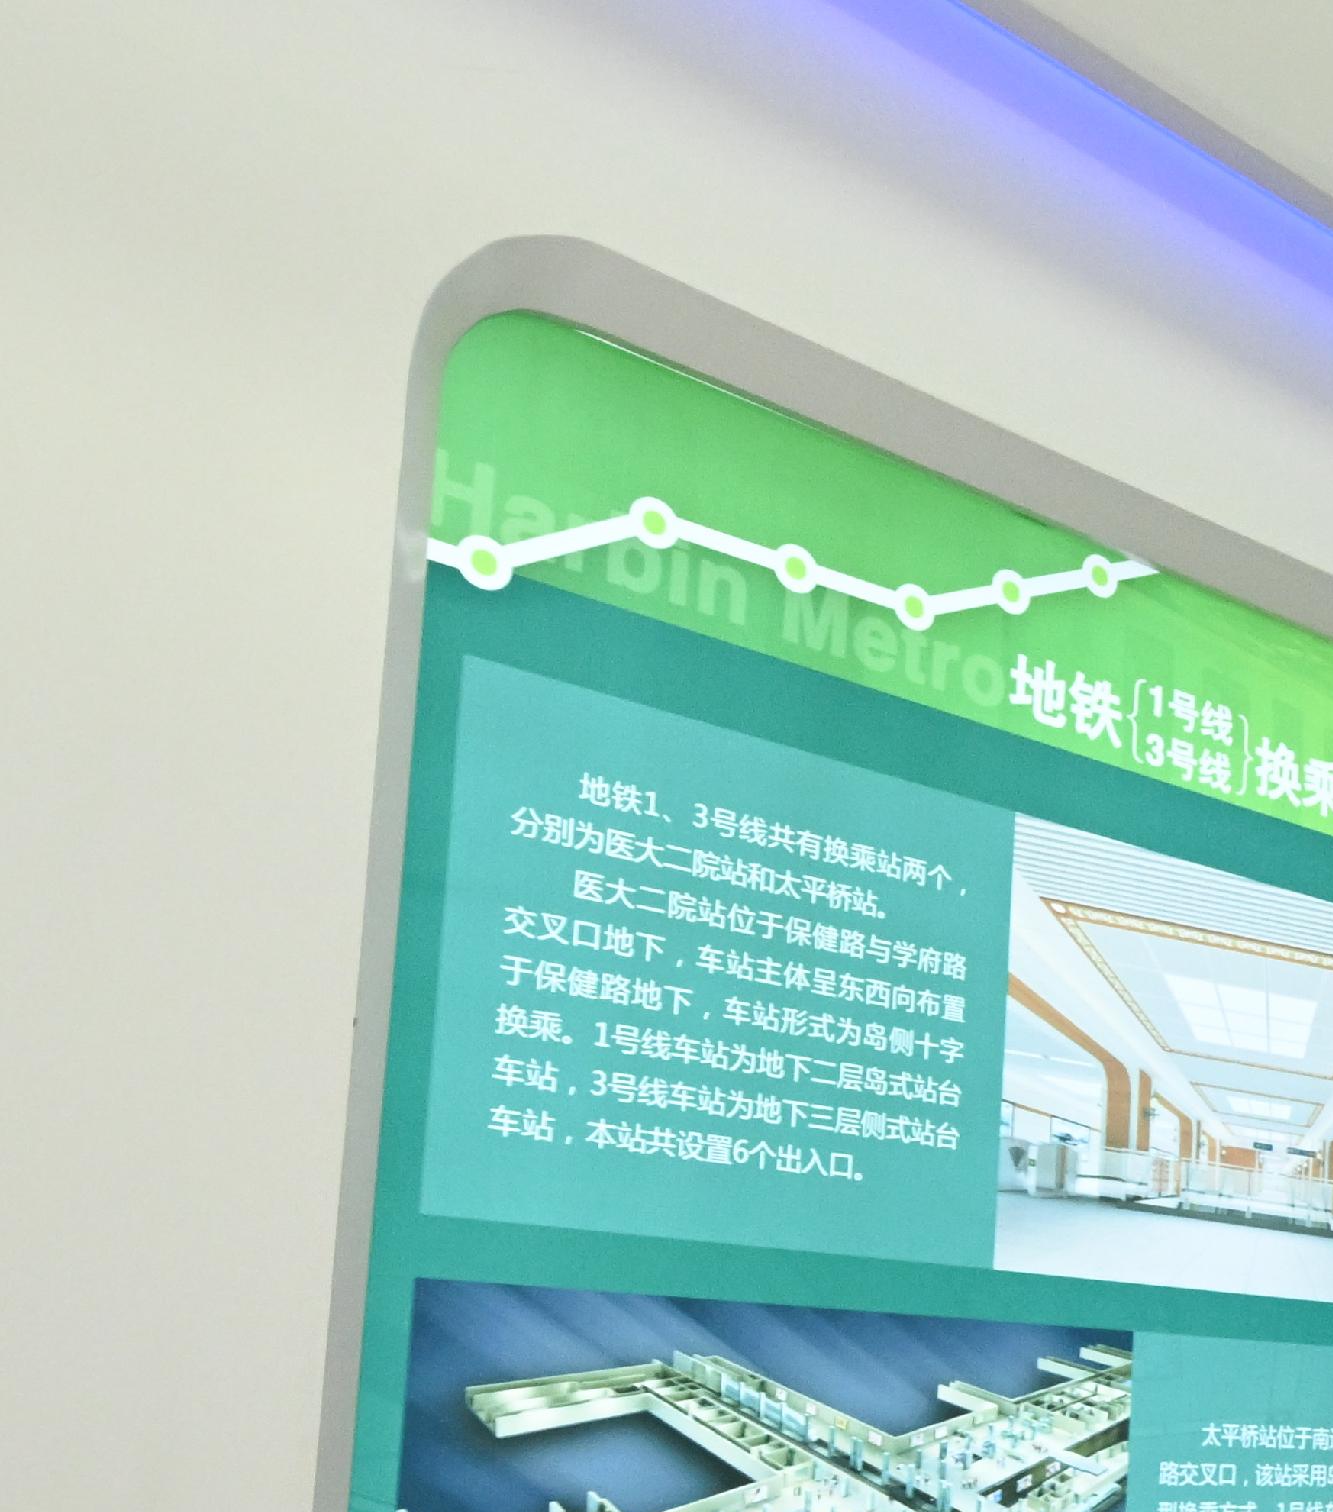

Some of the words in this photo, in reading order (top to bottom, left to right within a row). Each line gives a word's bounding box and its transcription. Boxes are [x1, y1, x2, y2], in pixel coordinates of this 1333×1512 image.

[431, 449, 749, 626] Harbin
[782, 582, 1009, 707] Metro
[1010, 653, 1123, 749] 地铁
[1149, 685, 1234, 746] 1号线
[1144, 733, 1232, 794] 3号线
[510, 806, 887, 920] 分别为医大二院站和太平桥站。
[503, 906, 967, 1024] 交叉口地下，车站主体呈东西向布置
[573, 869, 968, 981] 医大二院站位于保健路与学府路
[499, 956, 965, 1064] 于保健路地下，车站形式为岛侧十字
